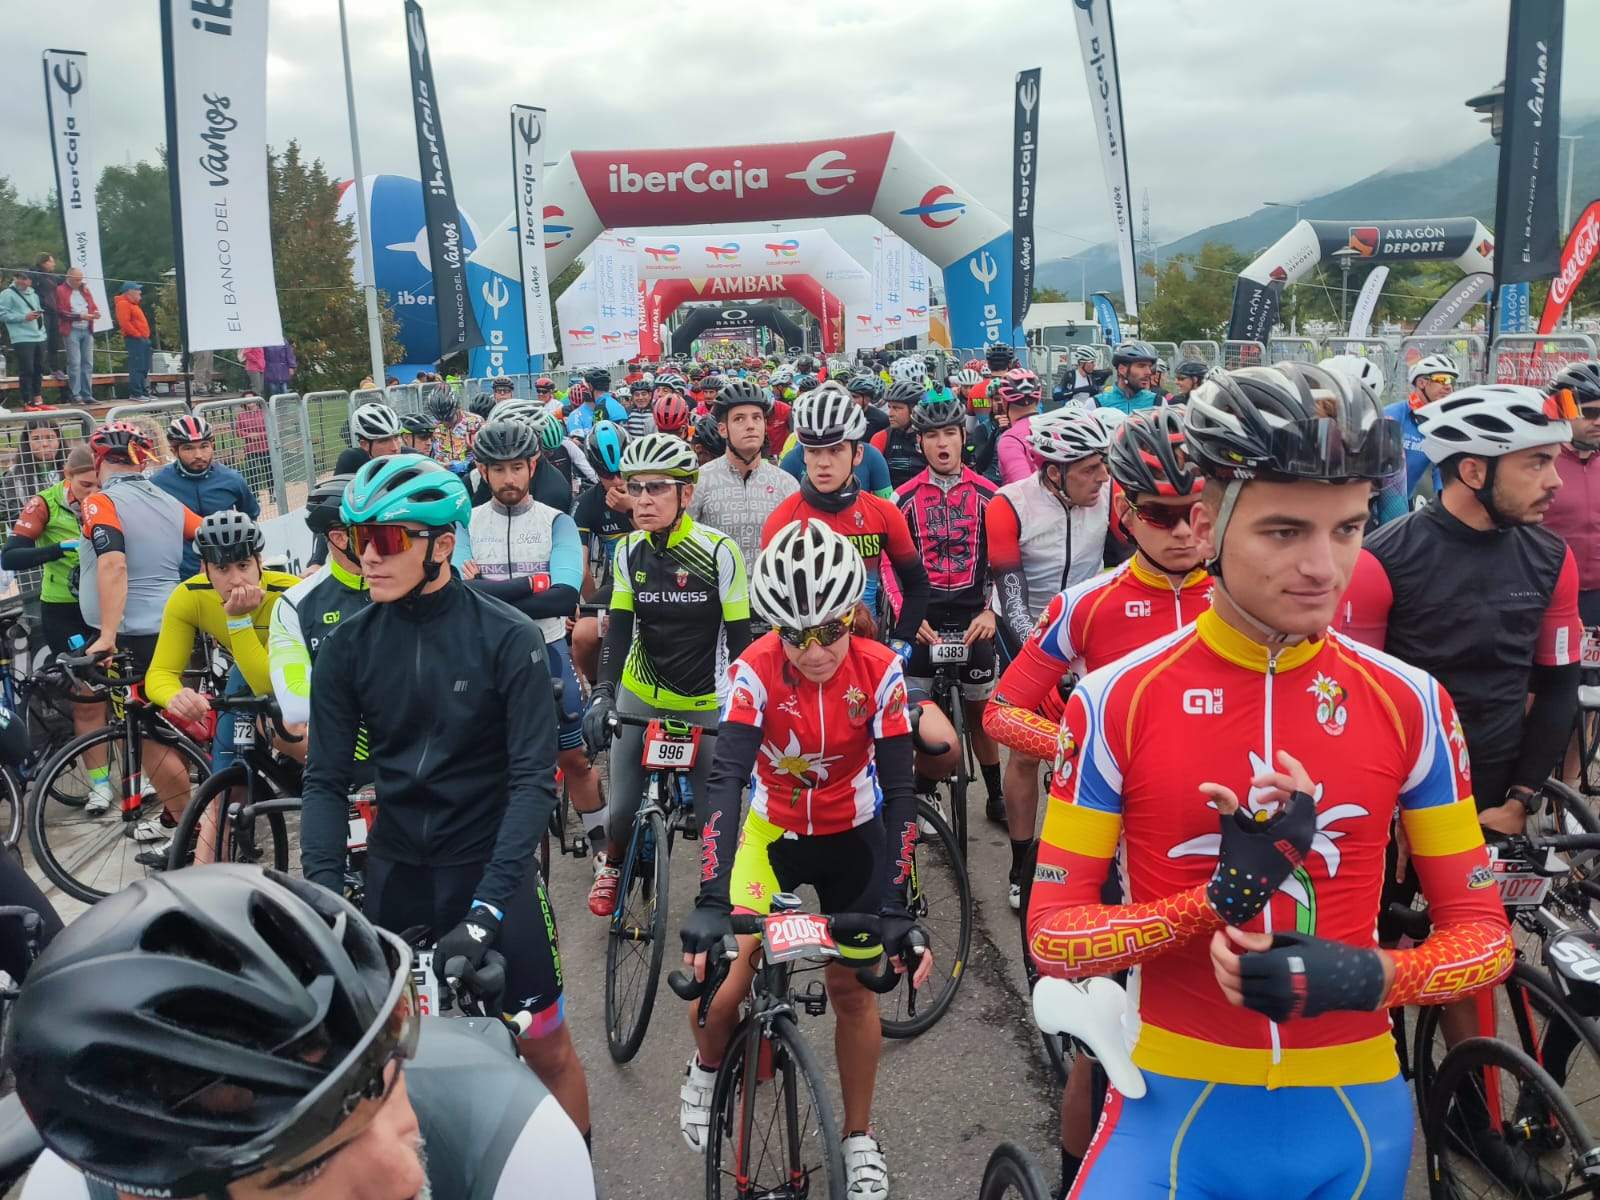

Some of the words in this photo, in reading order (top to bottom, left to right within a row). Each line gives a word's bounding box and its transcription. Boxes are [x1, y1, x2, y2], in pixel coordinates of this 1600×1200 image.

[199, 92, 238, 187] Vamos
[418, 79, 448, 197] iberCaja
[63, 116, 82, 209] iberCaja
[608, 158, 769, 199] iberCaja
[1018, 130, 1035, 218] iberCaja
[216, 197, 232, 232] DEL
[522, 163, 536, 247] iberCaja
[442, 221, 460, 269] Vamos
[1384, 241, 1445, 254] DEPORTE
[1386, 225, 1445, 240] ARAGÓN
[219, 239, 237, 306] BANCO
[454, 272, 462, 292] DEL
[711, 274, 787, 295] AMBAR
[456, 294, 465, 328] BANCO
[639, 290, 649, 333] AMBAR
[1446, 276, 1485, 315] DEPORTE
[228, 311, 242, 332] EL
[458, 329, 465, 342] EL
[652, 308, 660, 344] AMBAR
[516, 561, 547, 572] BIKE
[638, 591, 708, 603] EDELWEISS
[937, 646, 964, 658] 4383
[658, 744, 684, 760] 996
[1500, 878, 1543, 897] 1077
[769, 918, 828, 945] 20067
